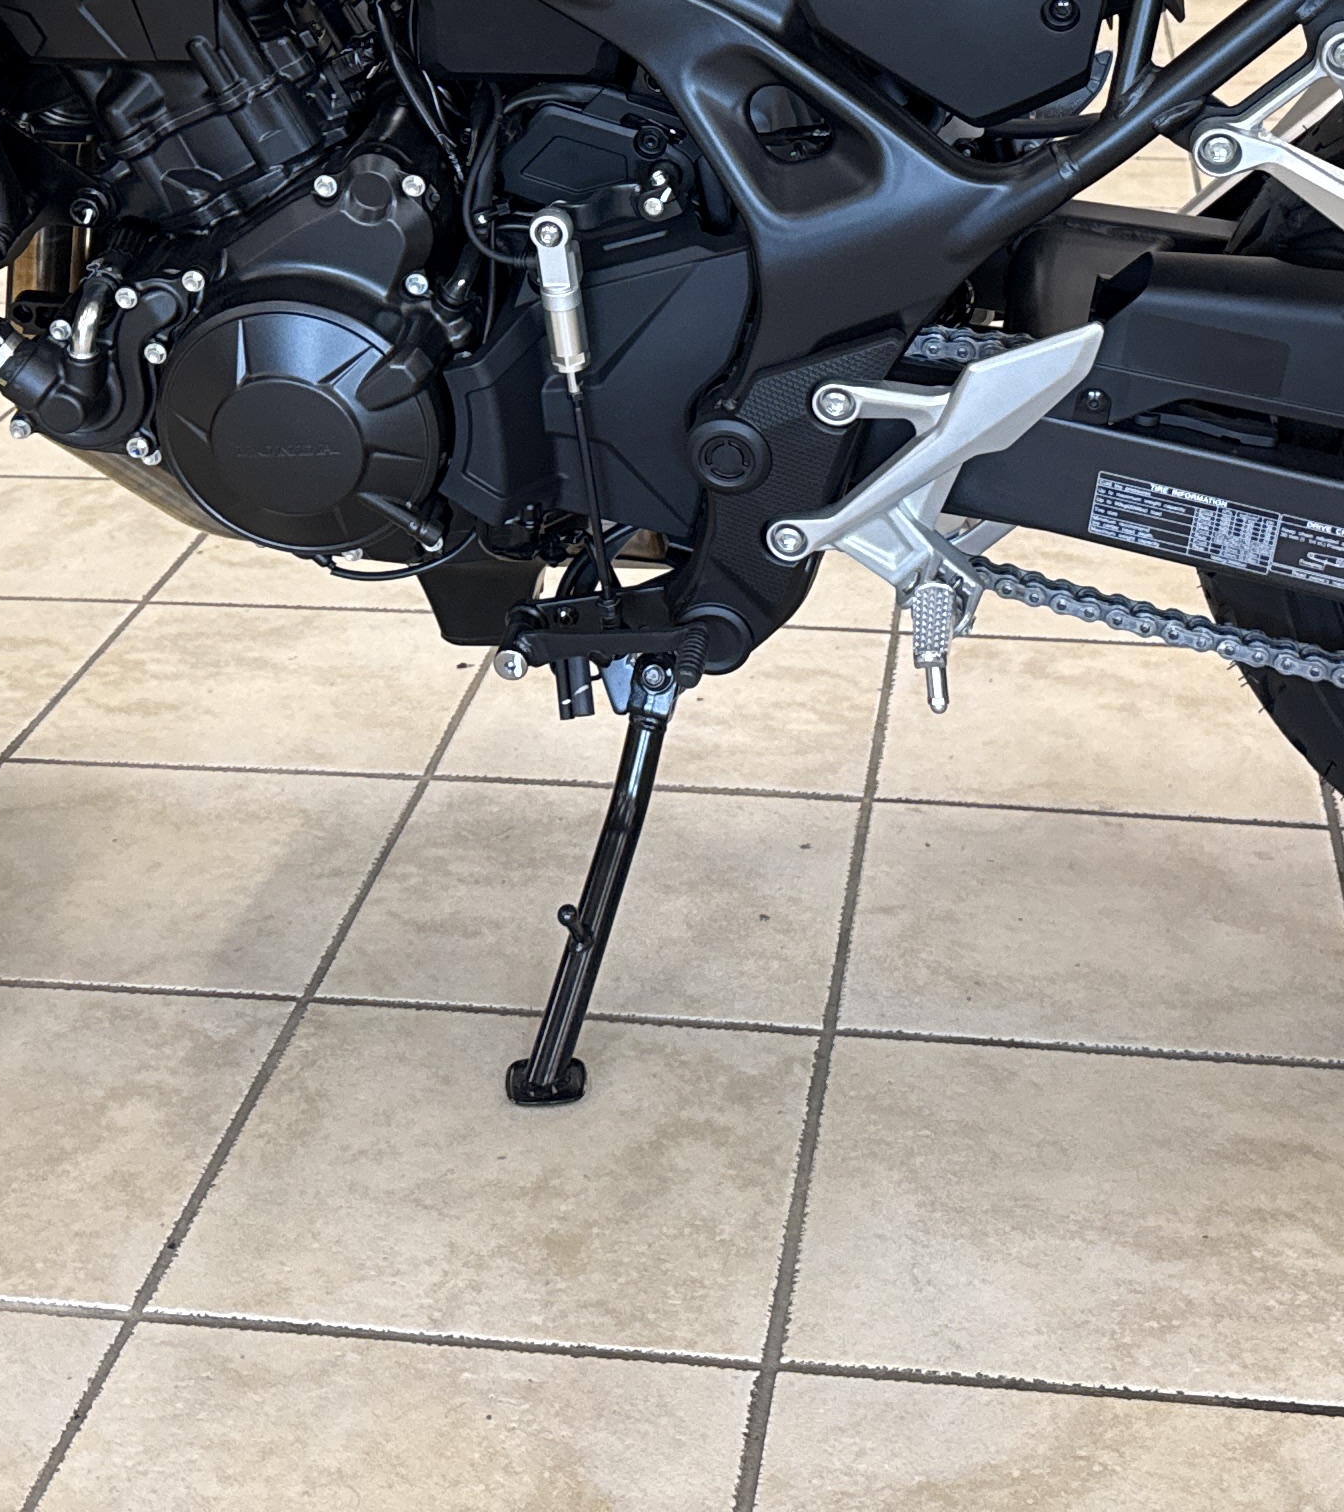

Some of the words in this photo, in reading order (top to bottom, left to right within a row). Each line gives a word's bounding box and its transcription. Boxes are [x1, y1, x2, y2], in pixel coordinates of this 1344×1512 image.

[235, 441, 342, 458] HONDA
[1150, 483, 1170, 495] TIRE
[1171, 488, 1228, 507] INFORMATION
[1306, 520, 1332, 533] DRIVE
